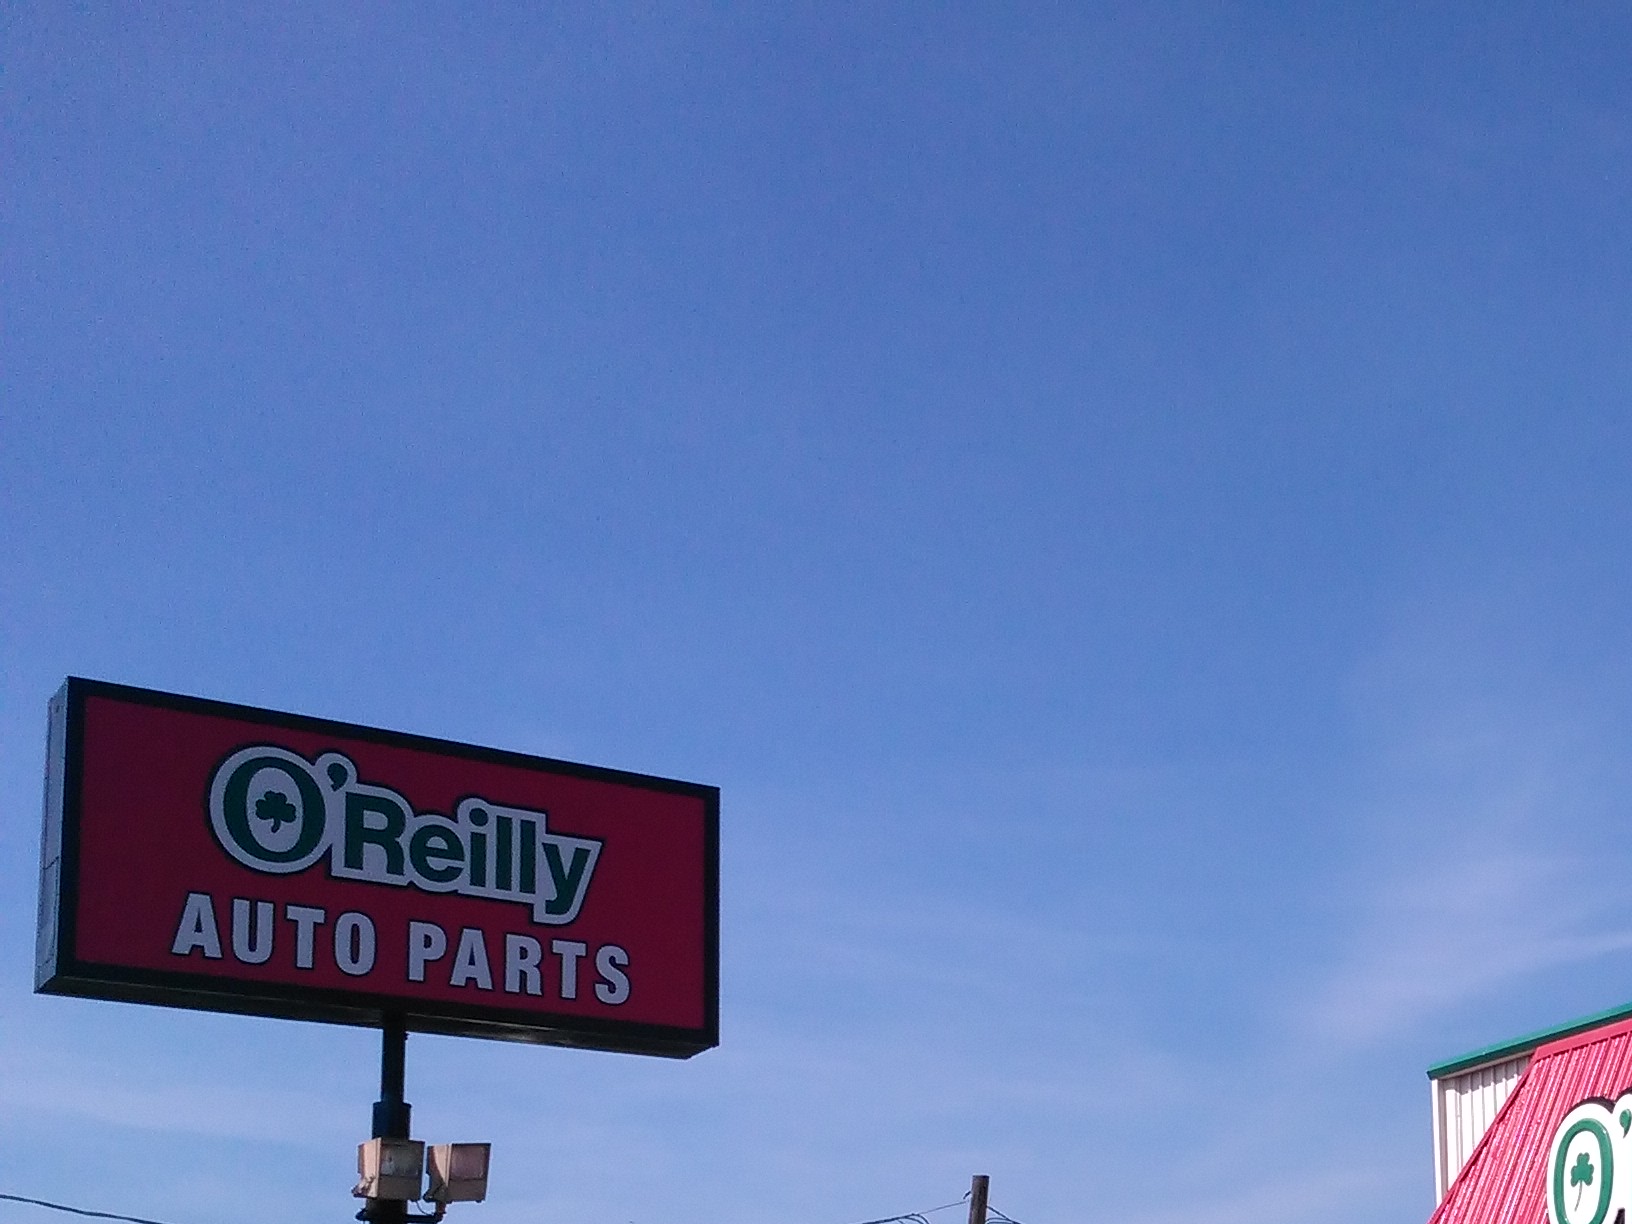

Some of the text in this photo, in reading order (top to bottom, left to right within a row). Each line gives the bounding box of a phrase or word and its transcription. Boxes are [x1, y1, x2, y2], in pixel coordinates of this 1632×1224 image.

[218, 752, 598, 918] O'Reilly
[171, 893, 631, 1004] AUTO PARTS
